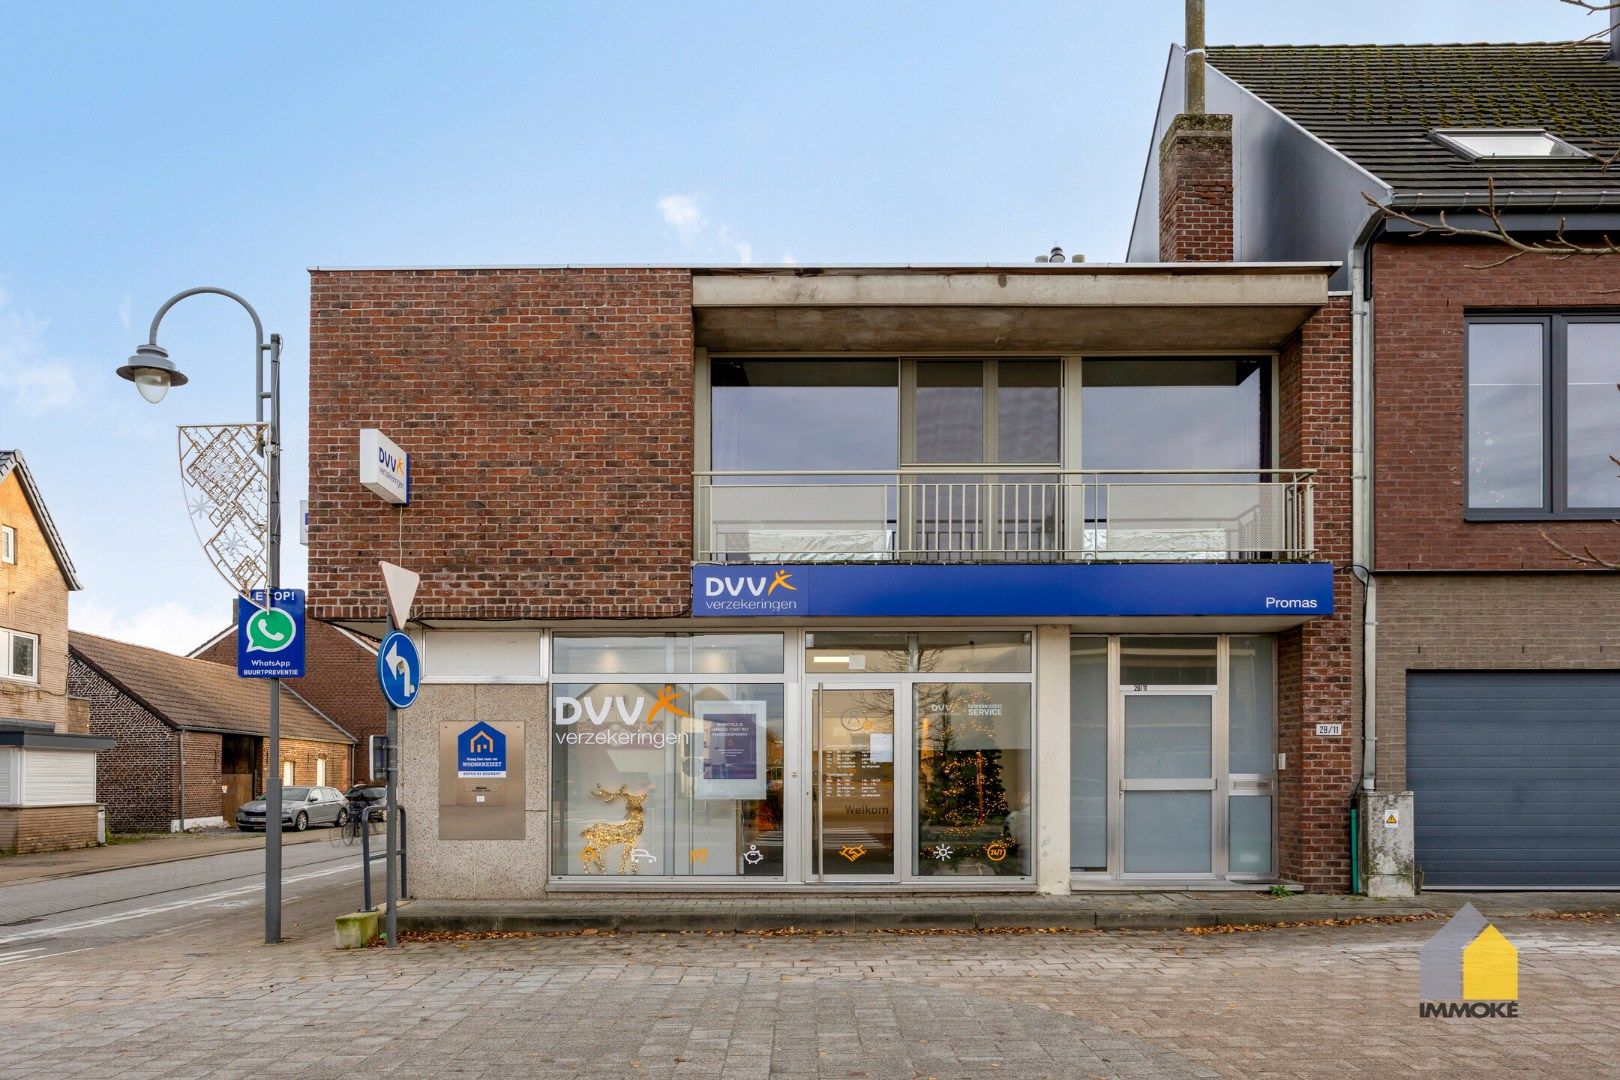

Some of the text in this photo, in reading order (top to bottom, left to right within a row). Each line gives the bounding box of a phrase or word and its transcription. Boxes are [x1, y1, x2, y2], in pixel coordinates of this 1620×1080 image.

[379, 447, 397, 473] DVV
[705, 577, 767, 597] DVV
[273, 591, 295, 601] OP!
[705, 599, 797, 612] verzekeringen
[1266, 597, 1318, 608] Promas
[555, 696, 645, 726] DVV
[968, 708, 1003, 716] SERVICE
[1319, 725, 1339, 734] 28/11
[555, 729, 689, 749] verzekeringen
[845, 805, 889, 814] Welkom
